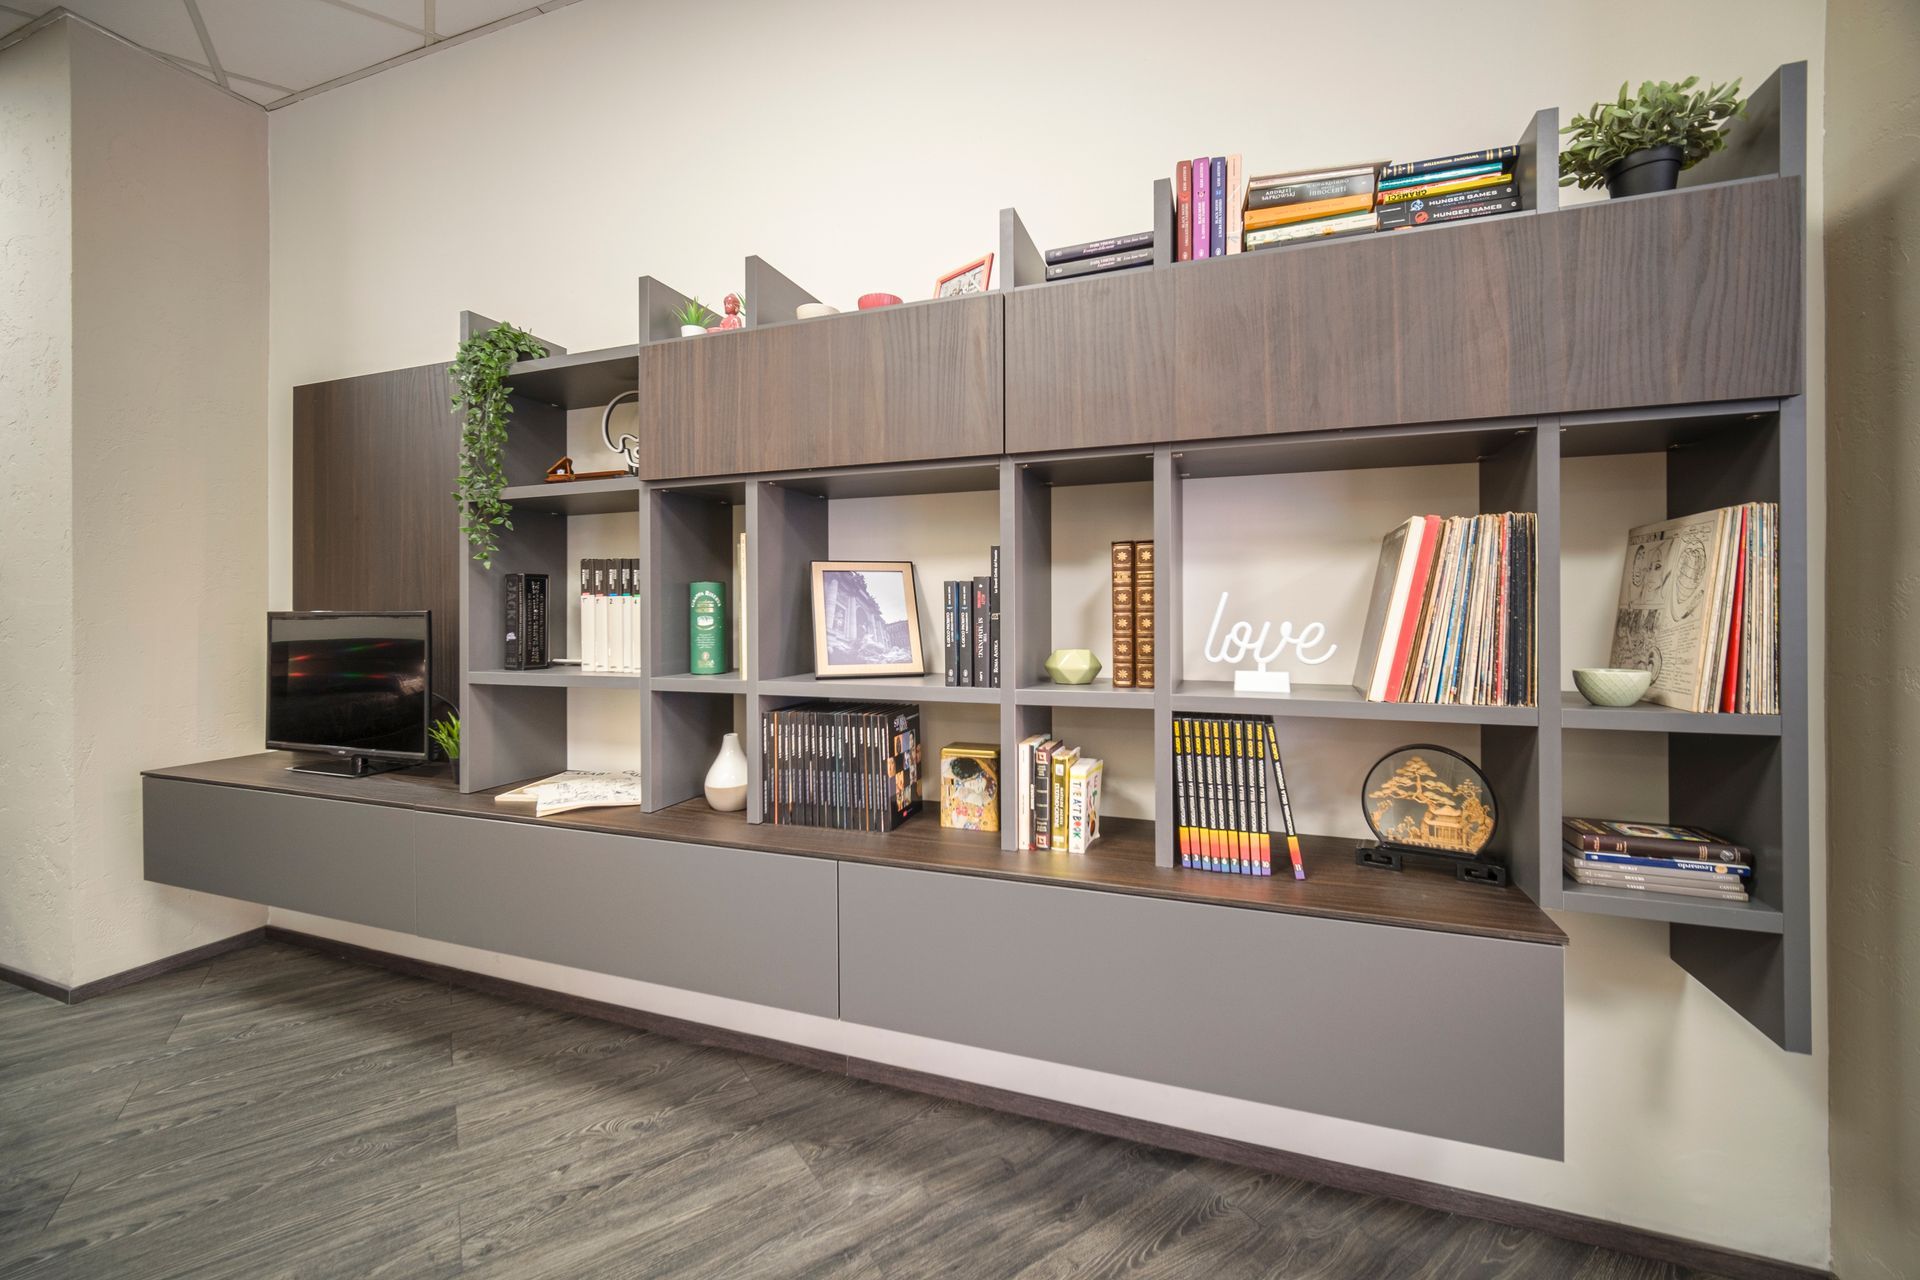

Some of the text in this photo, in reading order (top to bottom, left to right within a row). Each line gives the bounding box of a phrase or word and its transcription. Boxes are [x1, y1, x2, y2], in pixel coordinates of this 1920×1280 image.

[1388, 189, 1427, 201] GRAMSCI
[1428, 190, 1498, 206] HUNGER GAMES
[1433, 208, 1470, 218] HUNGER
[1472, 204, 1502, 213] GAMES
[507, 582, 516, 619] JACK
[1204, 591, 1337, 664] love
[1678, 863, 1713, 872] Leonardo
